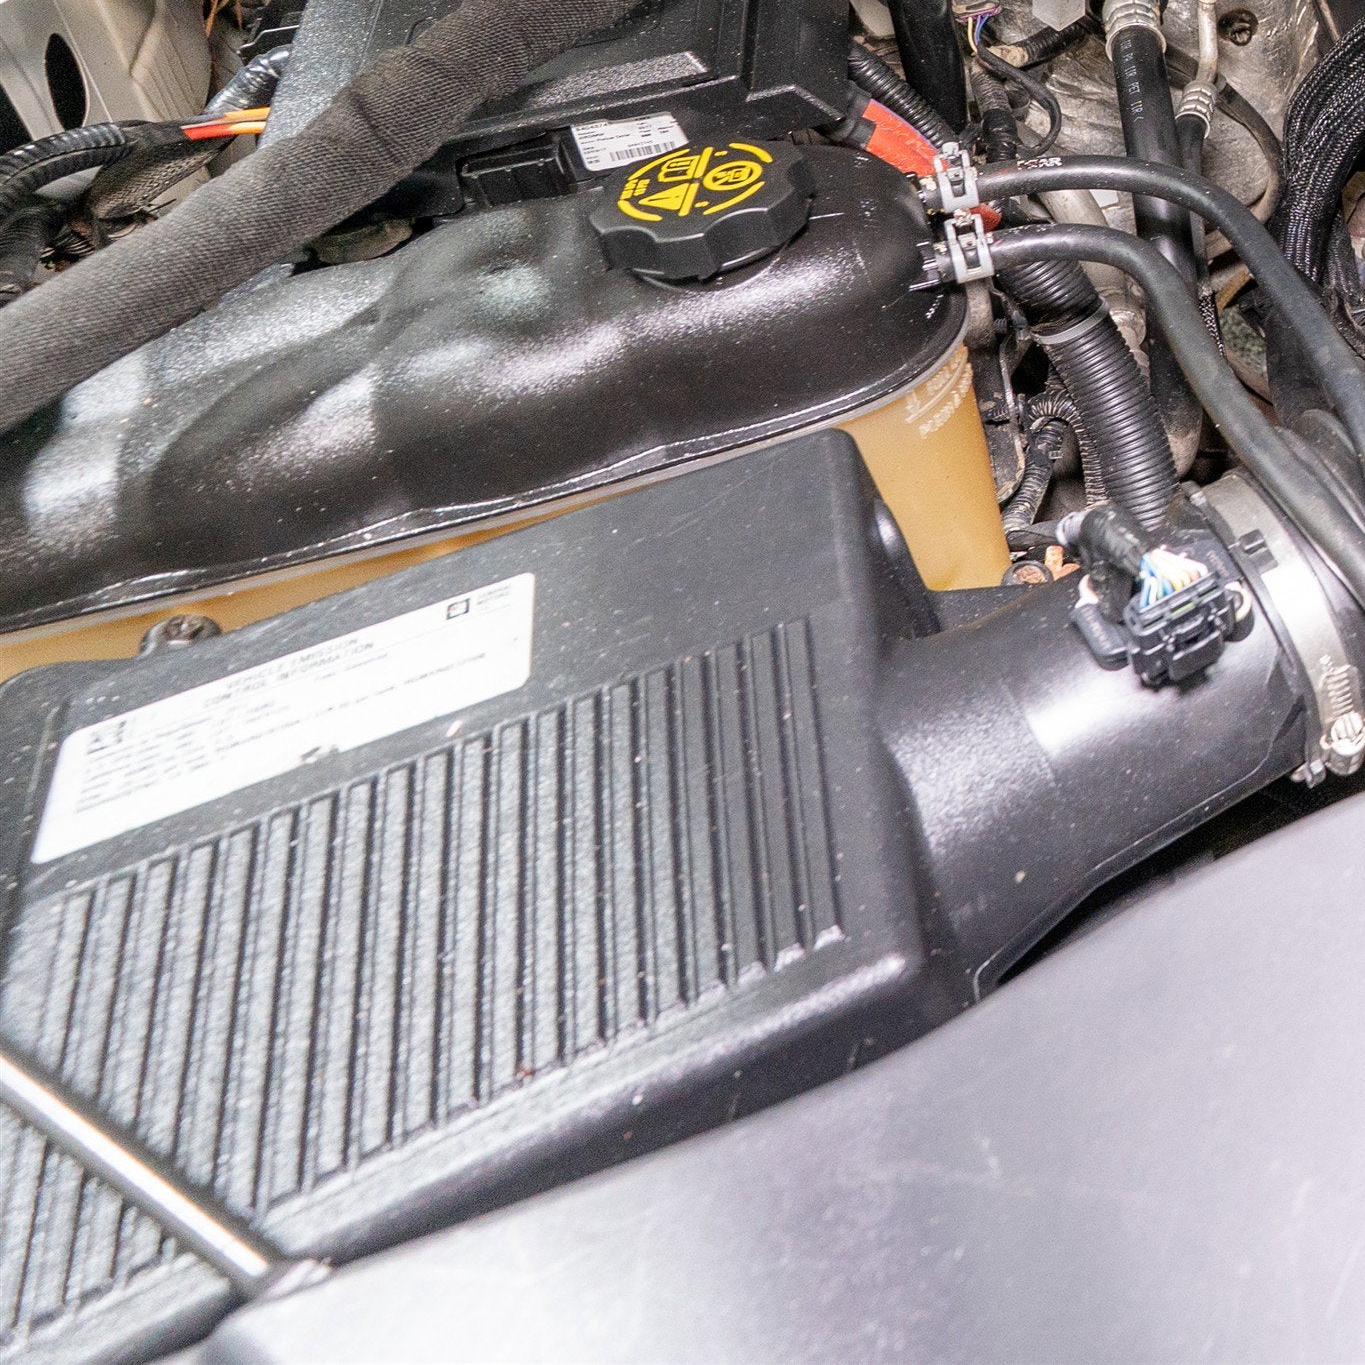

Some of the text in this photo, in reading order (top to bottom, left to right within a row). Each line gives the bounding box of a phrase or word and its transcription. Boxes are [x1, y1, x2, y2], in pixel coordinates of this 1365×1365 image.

[1128, 82, 1140, 94] PET
[277, 639, 374, 682] INFORMATION
[226, 662, 283, 690] VEHICLE
